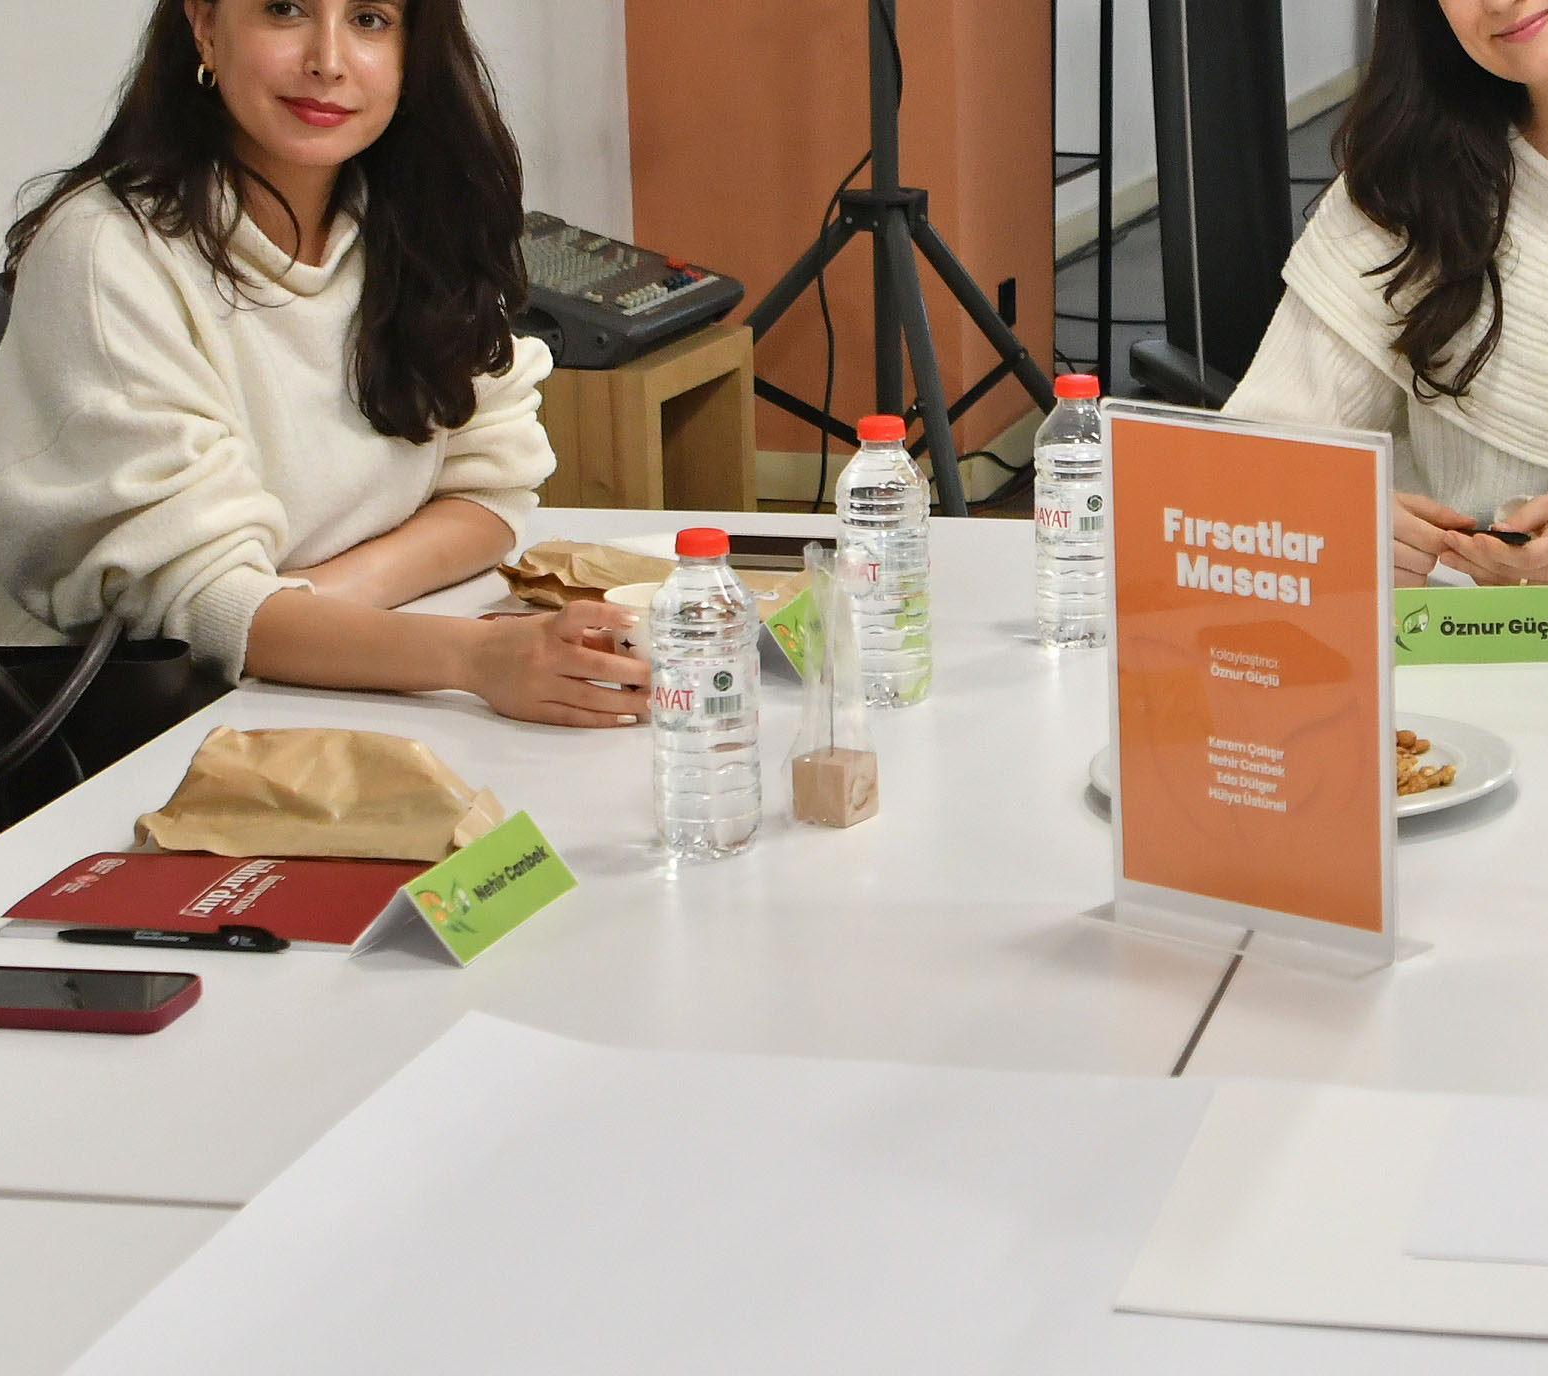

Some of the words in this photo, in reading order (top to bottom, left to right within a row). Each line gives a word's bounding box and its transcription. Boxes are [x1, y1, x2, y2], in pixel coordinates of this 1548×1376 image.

[1163, 507, 1325, 564] Fırsatlar
[1176, 552, 1311, 606] Masası
[1440, 616, 1505, 636] Öznur
[1210, 661, 1245, 681] Öznur
[1246, 670, 1280, 689] Güçlü
[472, 872, 508, 903] Nehir
[504, 845, 550, 881] Canbek
